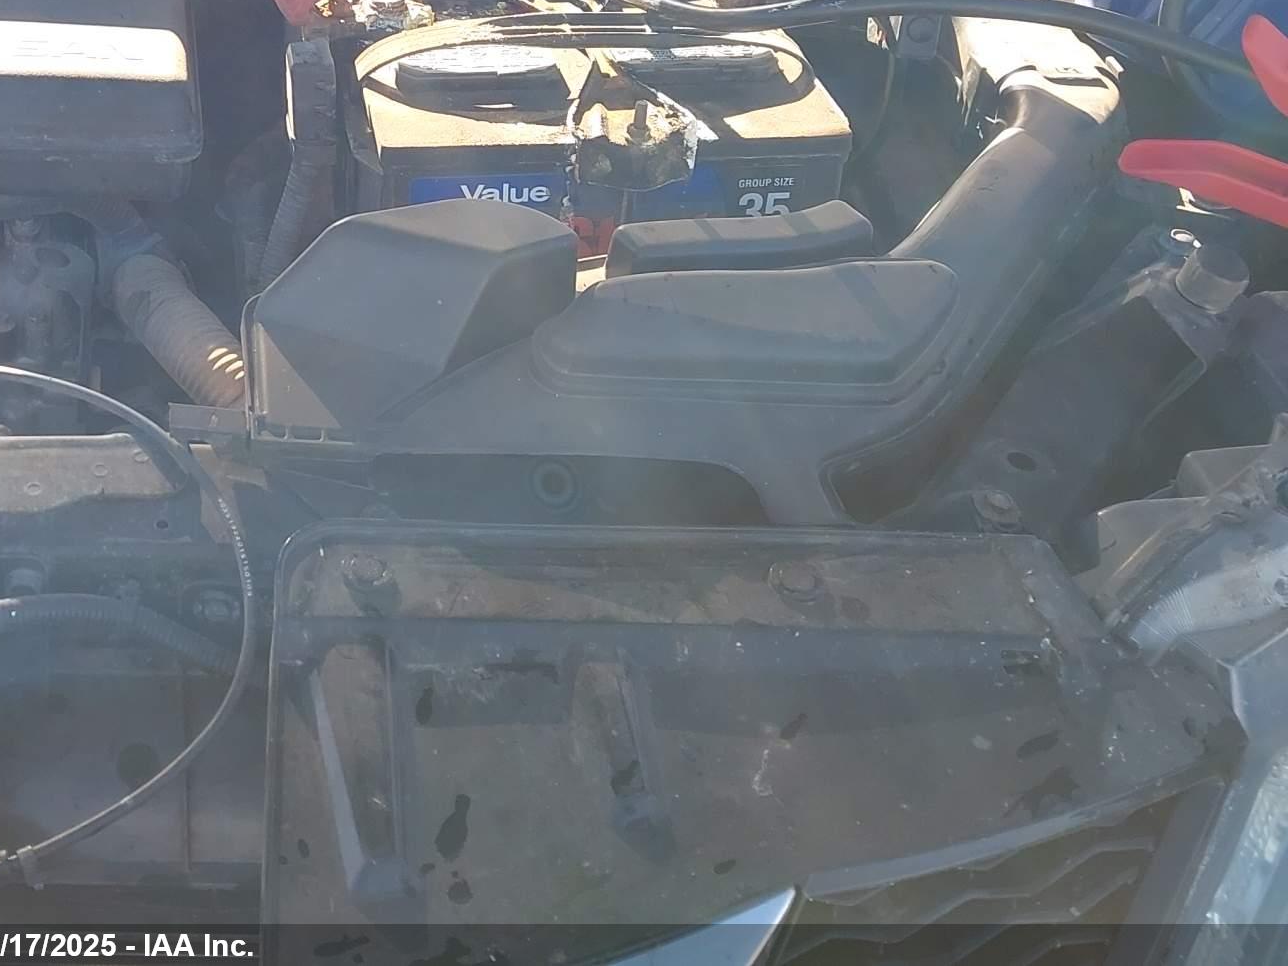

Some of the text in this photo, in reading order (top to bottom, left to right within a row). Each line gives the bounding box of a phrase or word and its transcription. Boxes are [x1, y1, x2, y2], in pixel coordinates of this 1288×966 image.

[460, 182, 552, 203] Value
[738, 177, 795, 188] GROUP SIZE
[738, 192, 791, 218] 35
